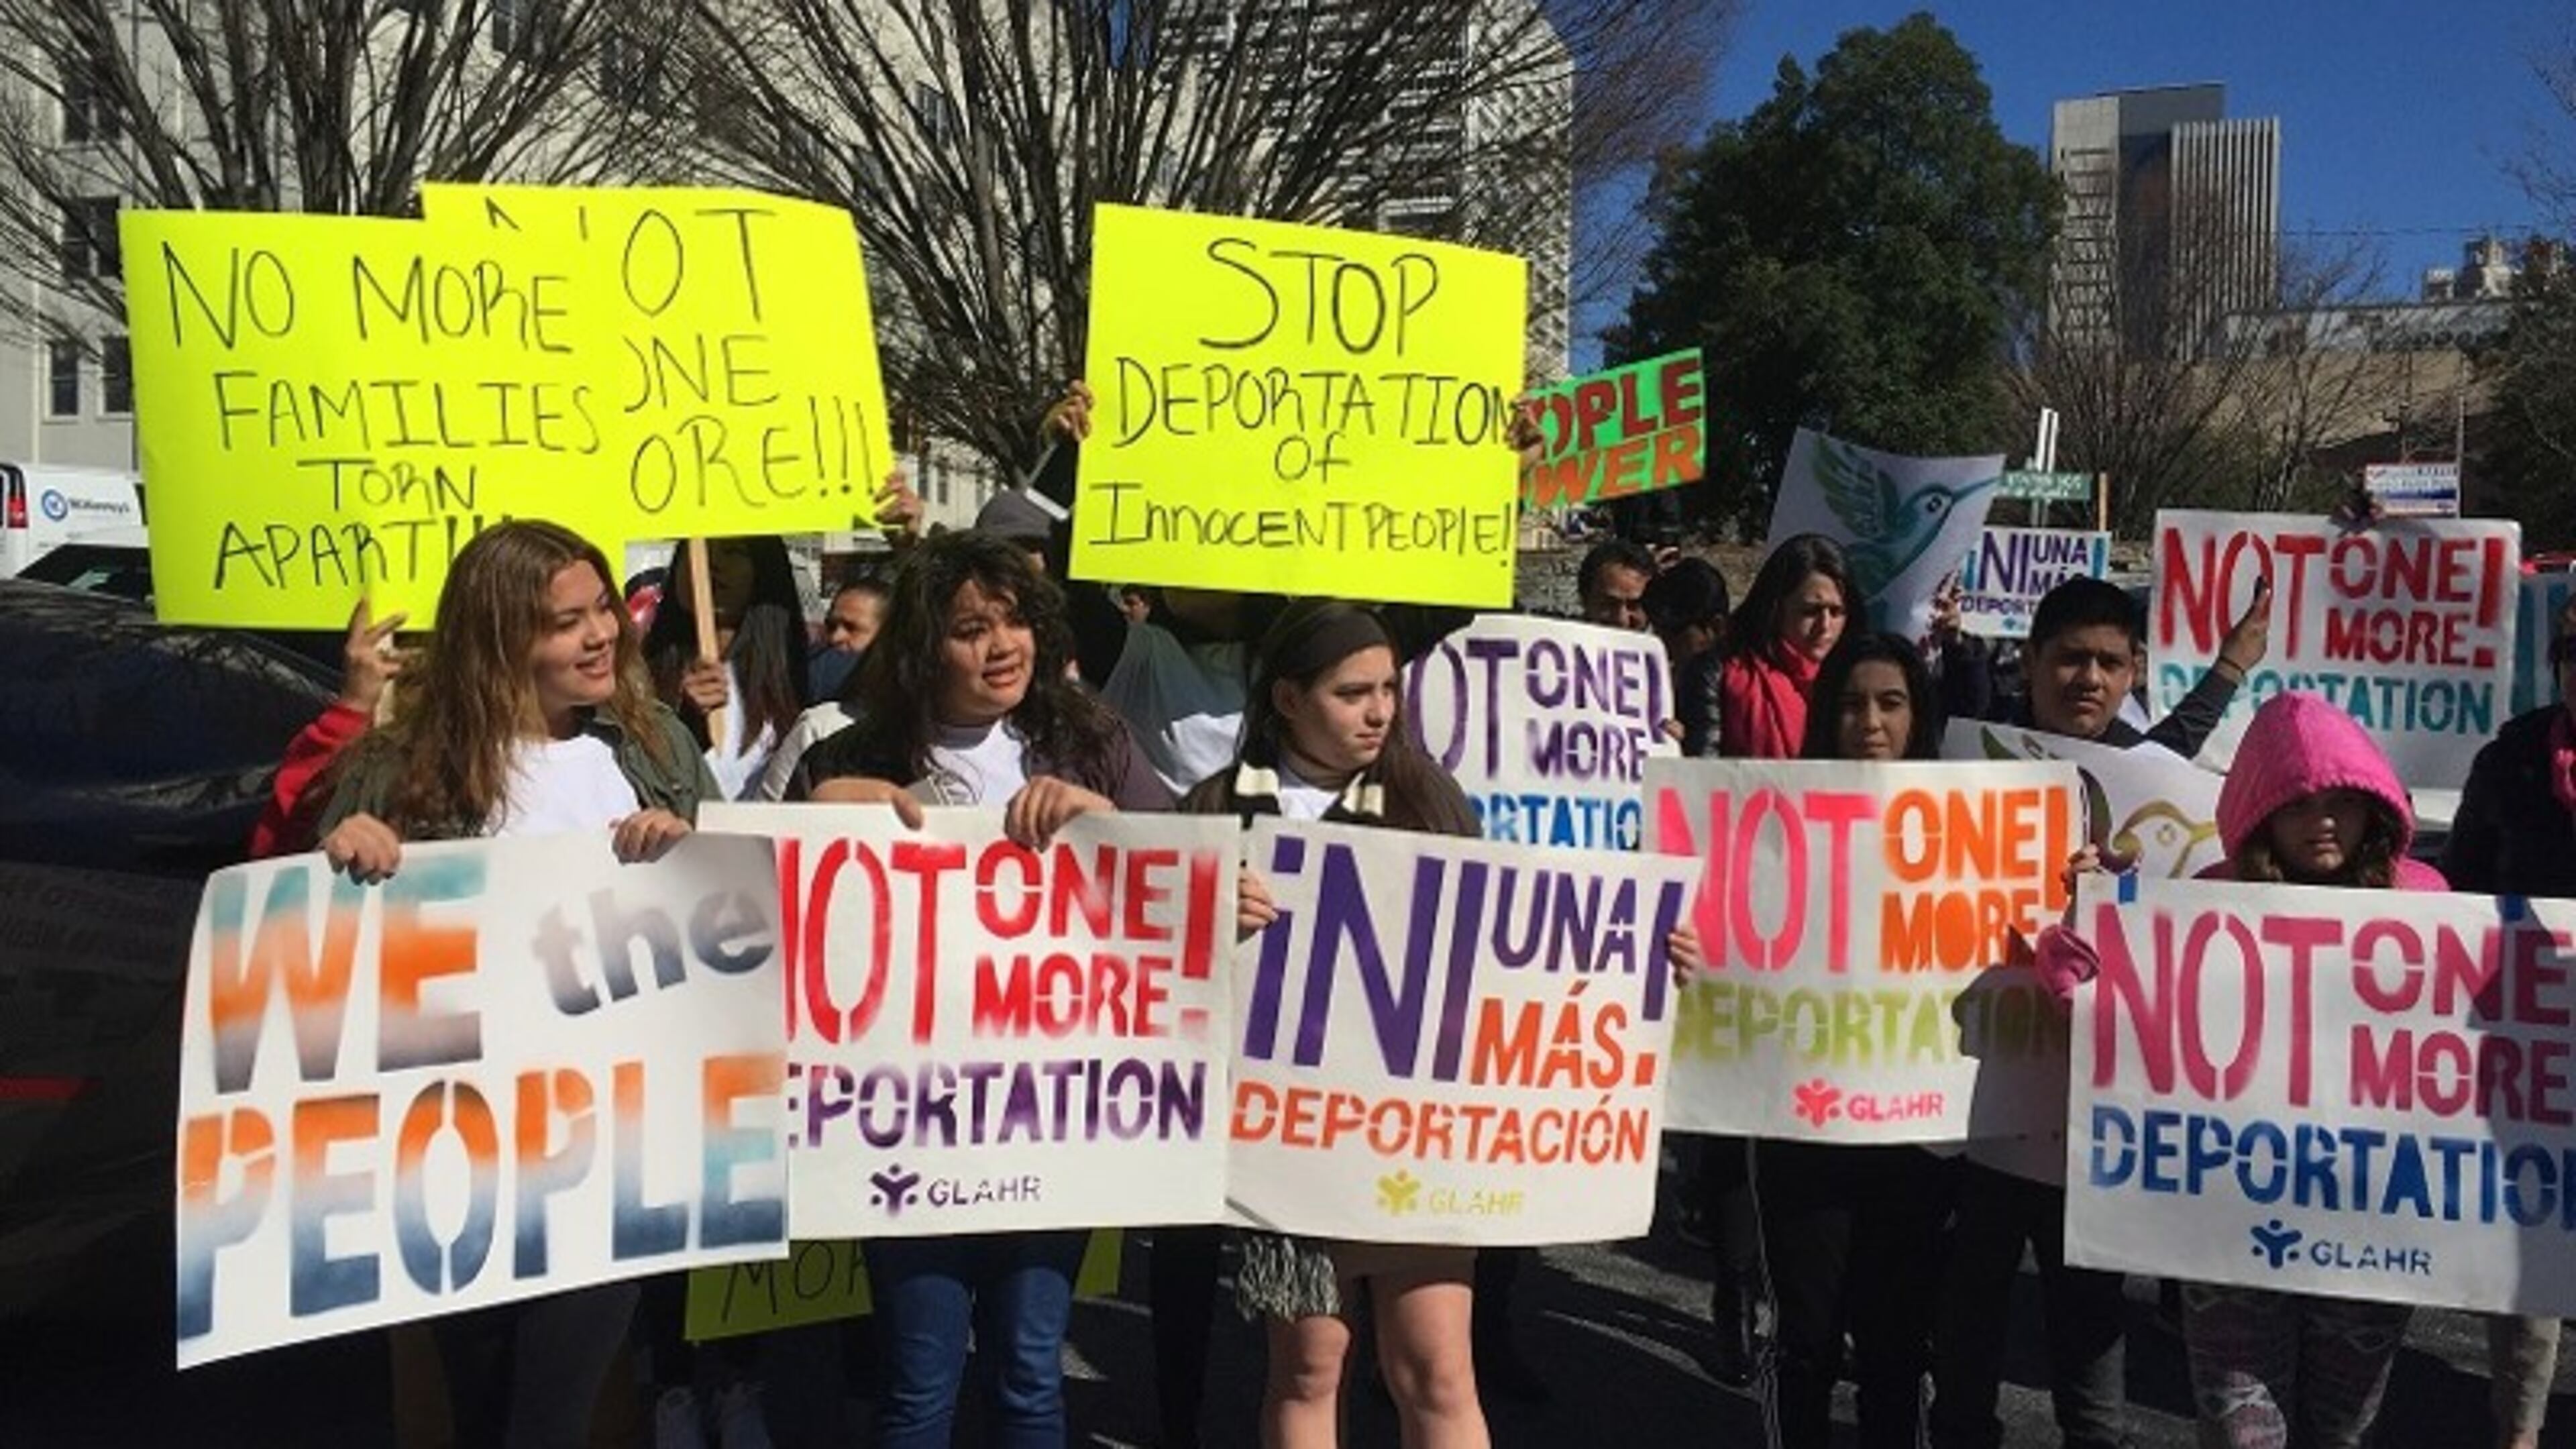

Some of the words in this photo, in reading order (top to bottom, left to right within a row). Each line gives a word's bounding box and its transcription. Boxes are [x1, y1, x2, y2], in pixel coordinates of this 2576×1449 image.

[162, 240, 294, 350] NO
[354, 256, 572, 353] MORE
[1199, 237, 1439, 356] STOP
[214, 370, 598, 454] FAMILIES
[1532, 358, 1701, 456] OPLE
[297, 459, 476, 515] TORN
[631, 396, 874, 514] ORE!!!
[1521, 426, 1703, 507] WER
[2159, 526, 2325, 660] NOT
[2324, 608, 2471, 668] MORE
[1406, 637, 1519, 780] OT
[1525, 718, 1648, 783] MORE
[1657, 786, 1878, 973] NOT
[210, 852, 489, 1094] WE
[535, 888, 775, 1017] the
[1880, 888, 2039, 973] MORE
[972, 951, 1173, 1038] MORE
[2092, 902, 2344, 1110] NOT
[2351, 919, 2575, 1027] ONE
[788, 1057, 1207, 1150] PORTATION
[1847, 1092, 1944, 1123] GLAHR
[2349, 1024, 2575, 1126] MORE
[1229, 1080, 1650, 1165] DEPORTACIÓN
[178, 1050, 789, 1343] PEOPLE
[927, 1175, 1041, 1207] GLAHR
[2310, 1241, 2433, 1276] GLAHR
